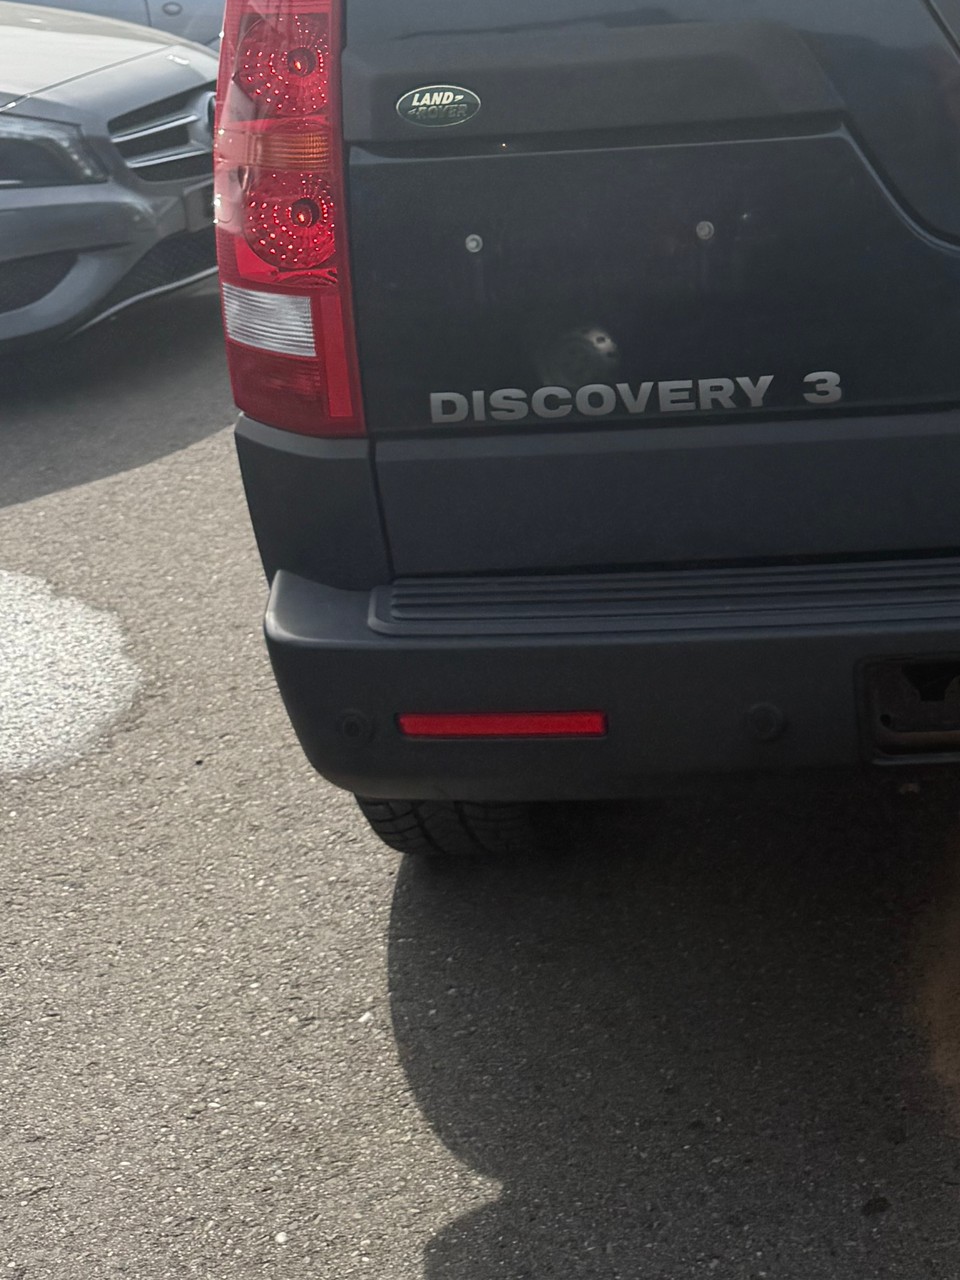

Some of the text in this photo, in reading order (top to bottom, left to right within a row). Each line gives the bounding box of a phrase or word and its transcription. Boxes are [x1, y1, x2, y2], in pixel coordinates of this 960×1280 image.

[412, 92, 454, 106] LAND
[429, 371, 842, 423] DISCOVERY 3
